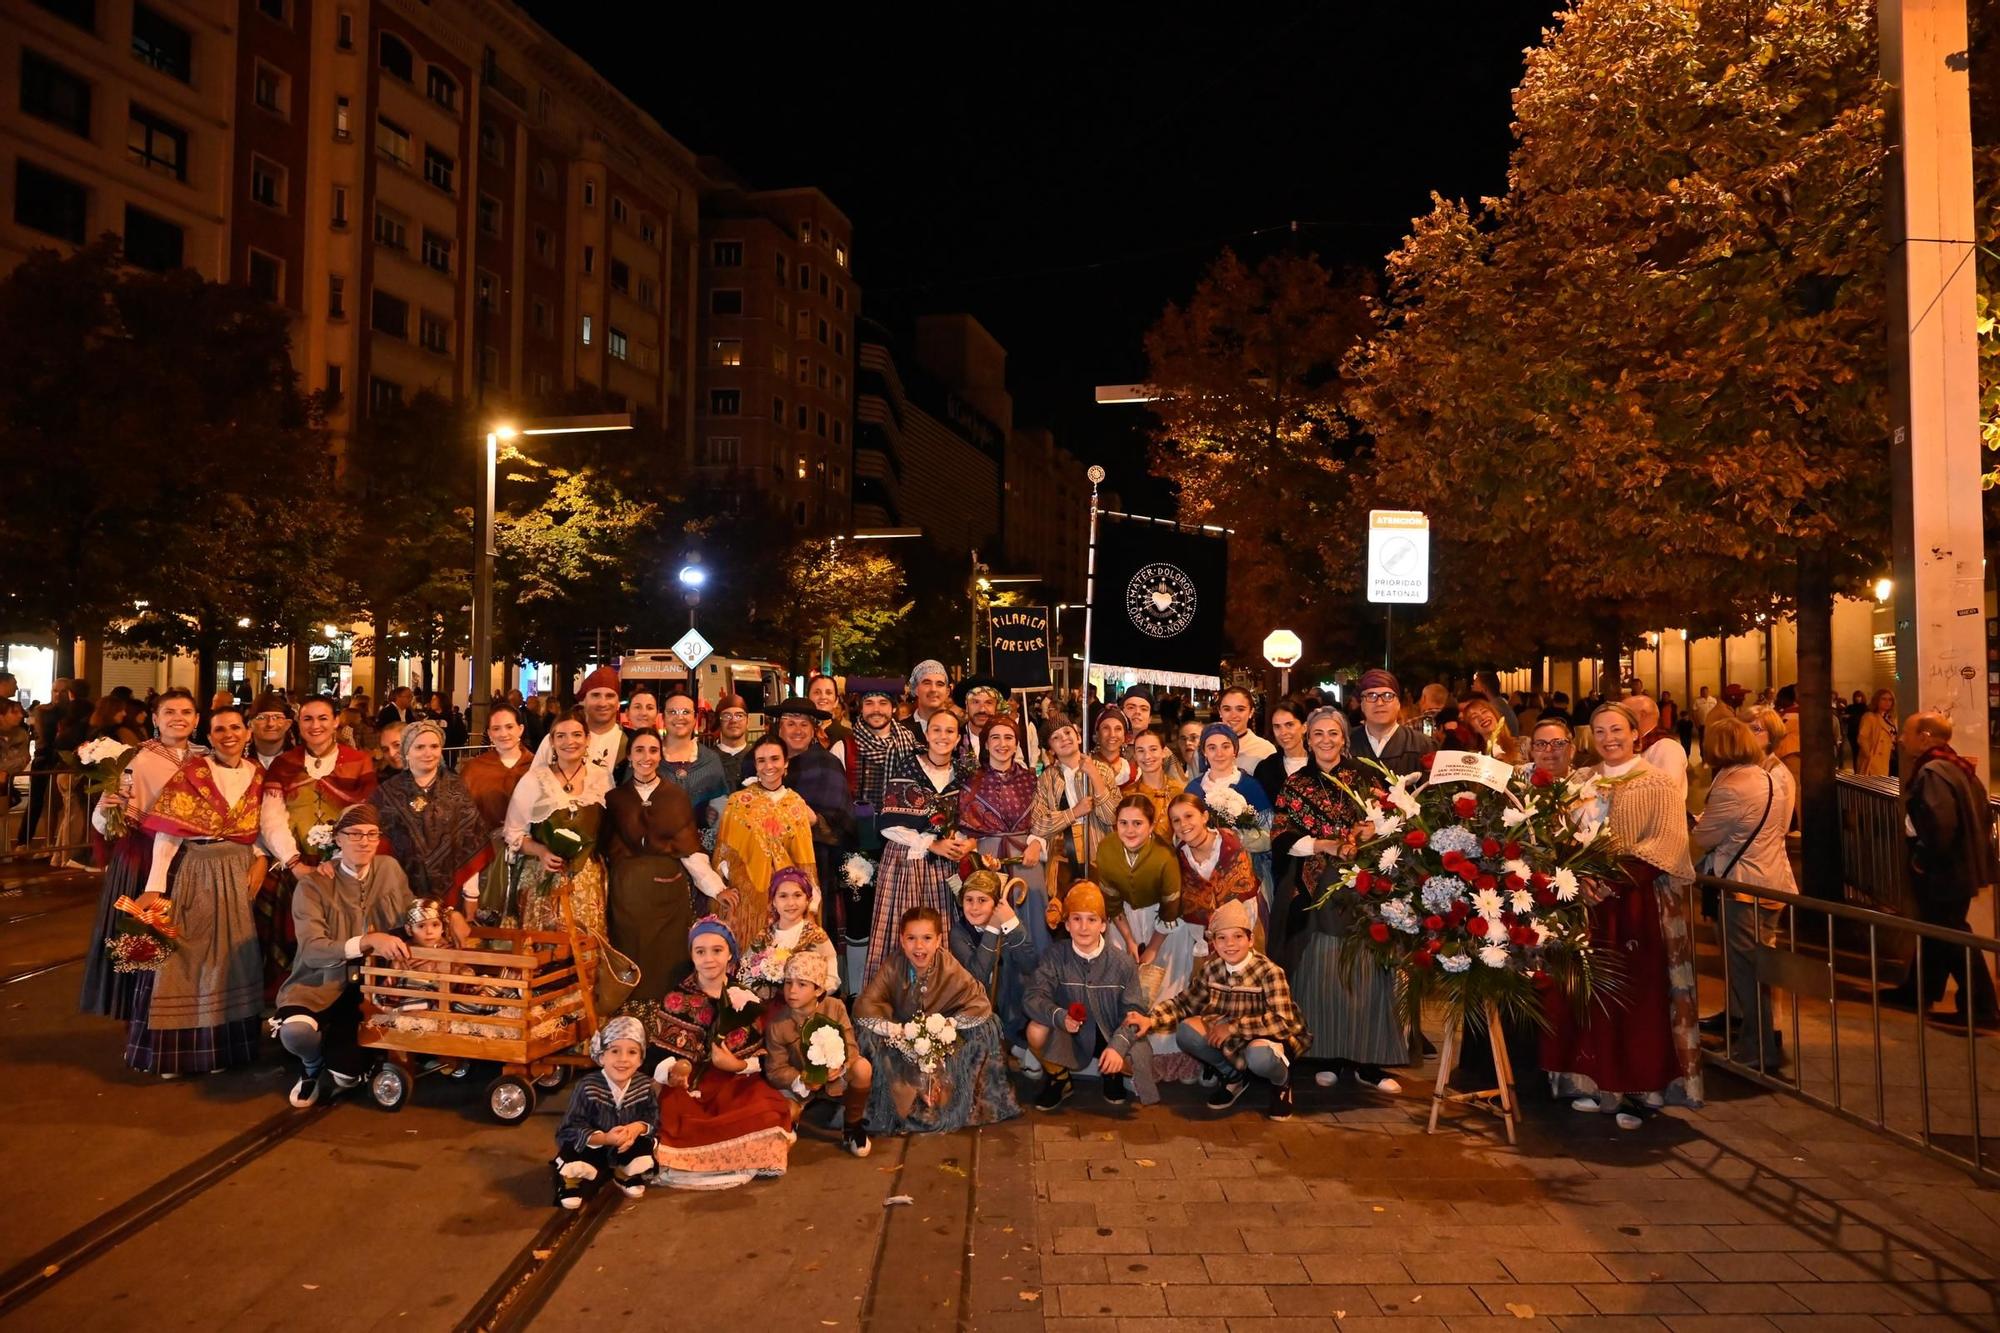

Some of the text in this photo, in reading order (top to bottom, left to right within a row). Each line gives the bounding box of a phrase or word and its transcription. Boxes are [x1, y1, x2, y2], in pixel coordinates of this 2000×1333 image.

[1130, 568, 1194, 603] MATER DOLOROSA
[1375, 579, 1422, 587] PRIORIDAD
[1375, 590, 1420, 598] PEATONAL
[1130, 607, 1190, 635] ORA PRO NOBIS
[683, 642, 702, 656] 30
[994, 637, 1045, 652] FOREVER
